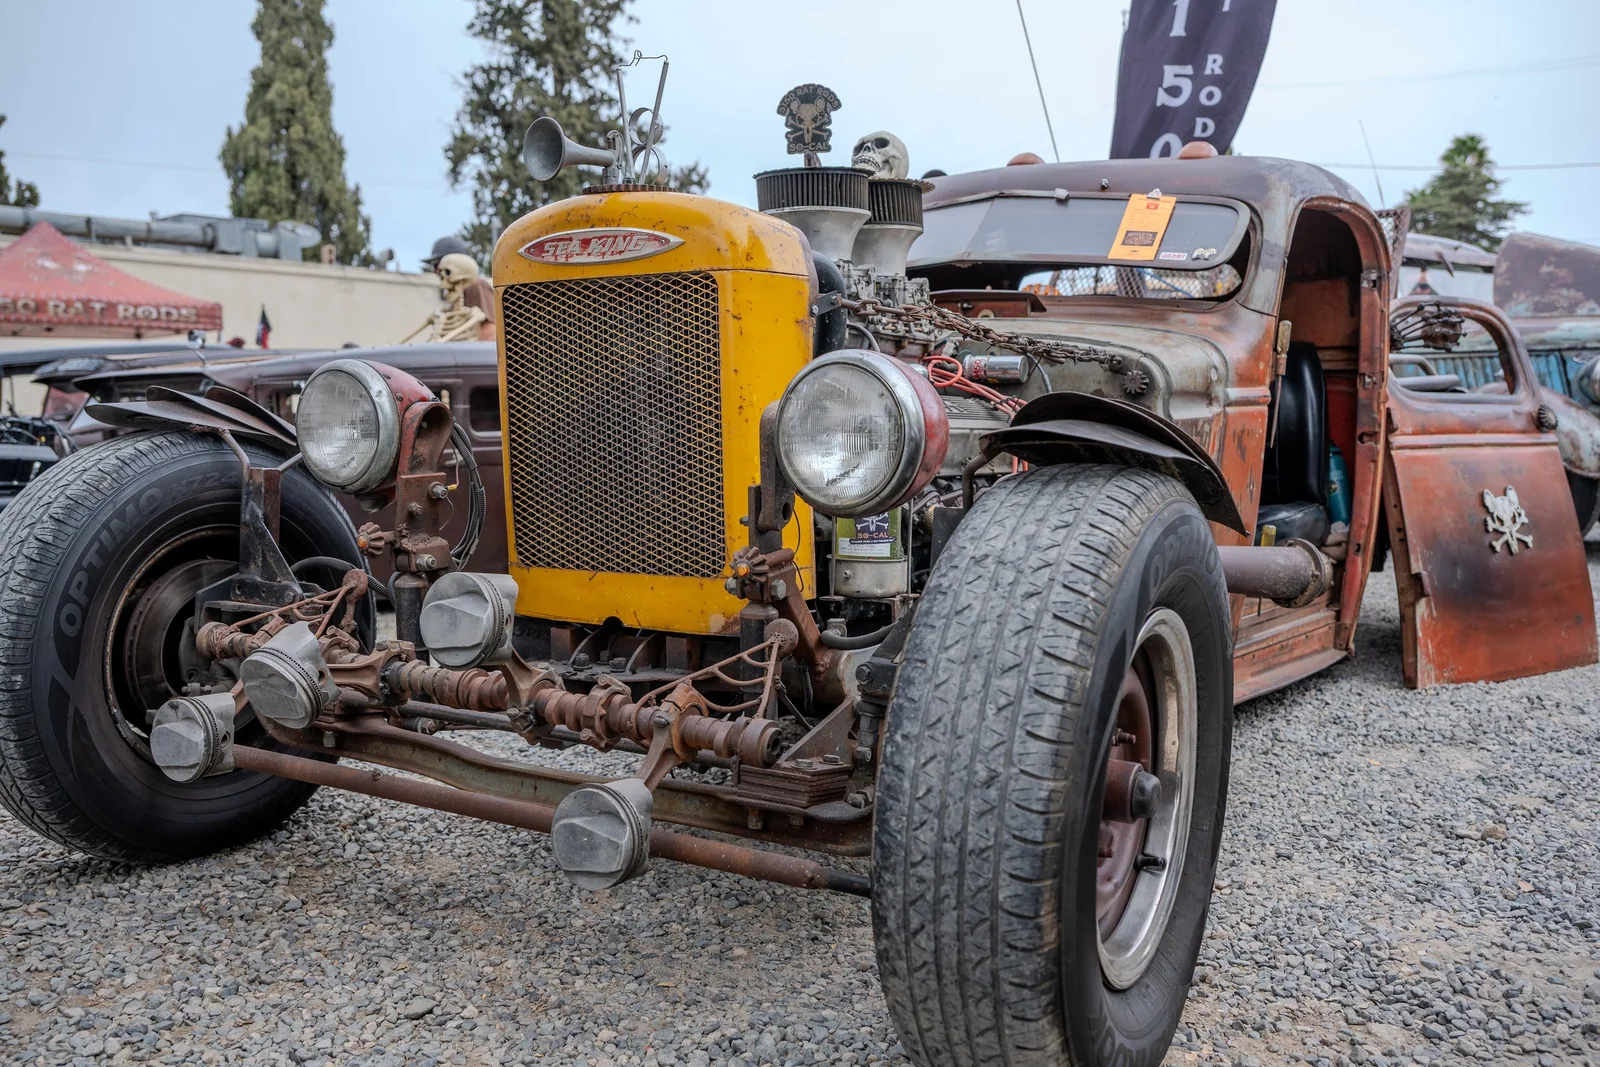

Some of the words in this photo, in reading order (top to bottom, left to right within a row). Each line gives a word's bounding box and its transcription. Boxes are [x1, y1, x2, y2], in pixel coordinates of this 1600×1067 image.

[796, 86, 814, 96] RAT
[816, 87, 840, 109] RODS
[789, 142, 829, 152] SO-CAL
[542, 238, 582, 258] SEA
[589, 235, 649, 255] KING
[47, 299, 106, 319] RAT
[116, 304, 199, 323] RODS
[857, 531, 889, 539] SO-CAL
[59, 487, 165, 638] OPTIMO
